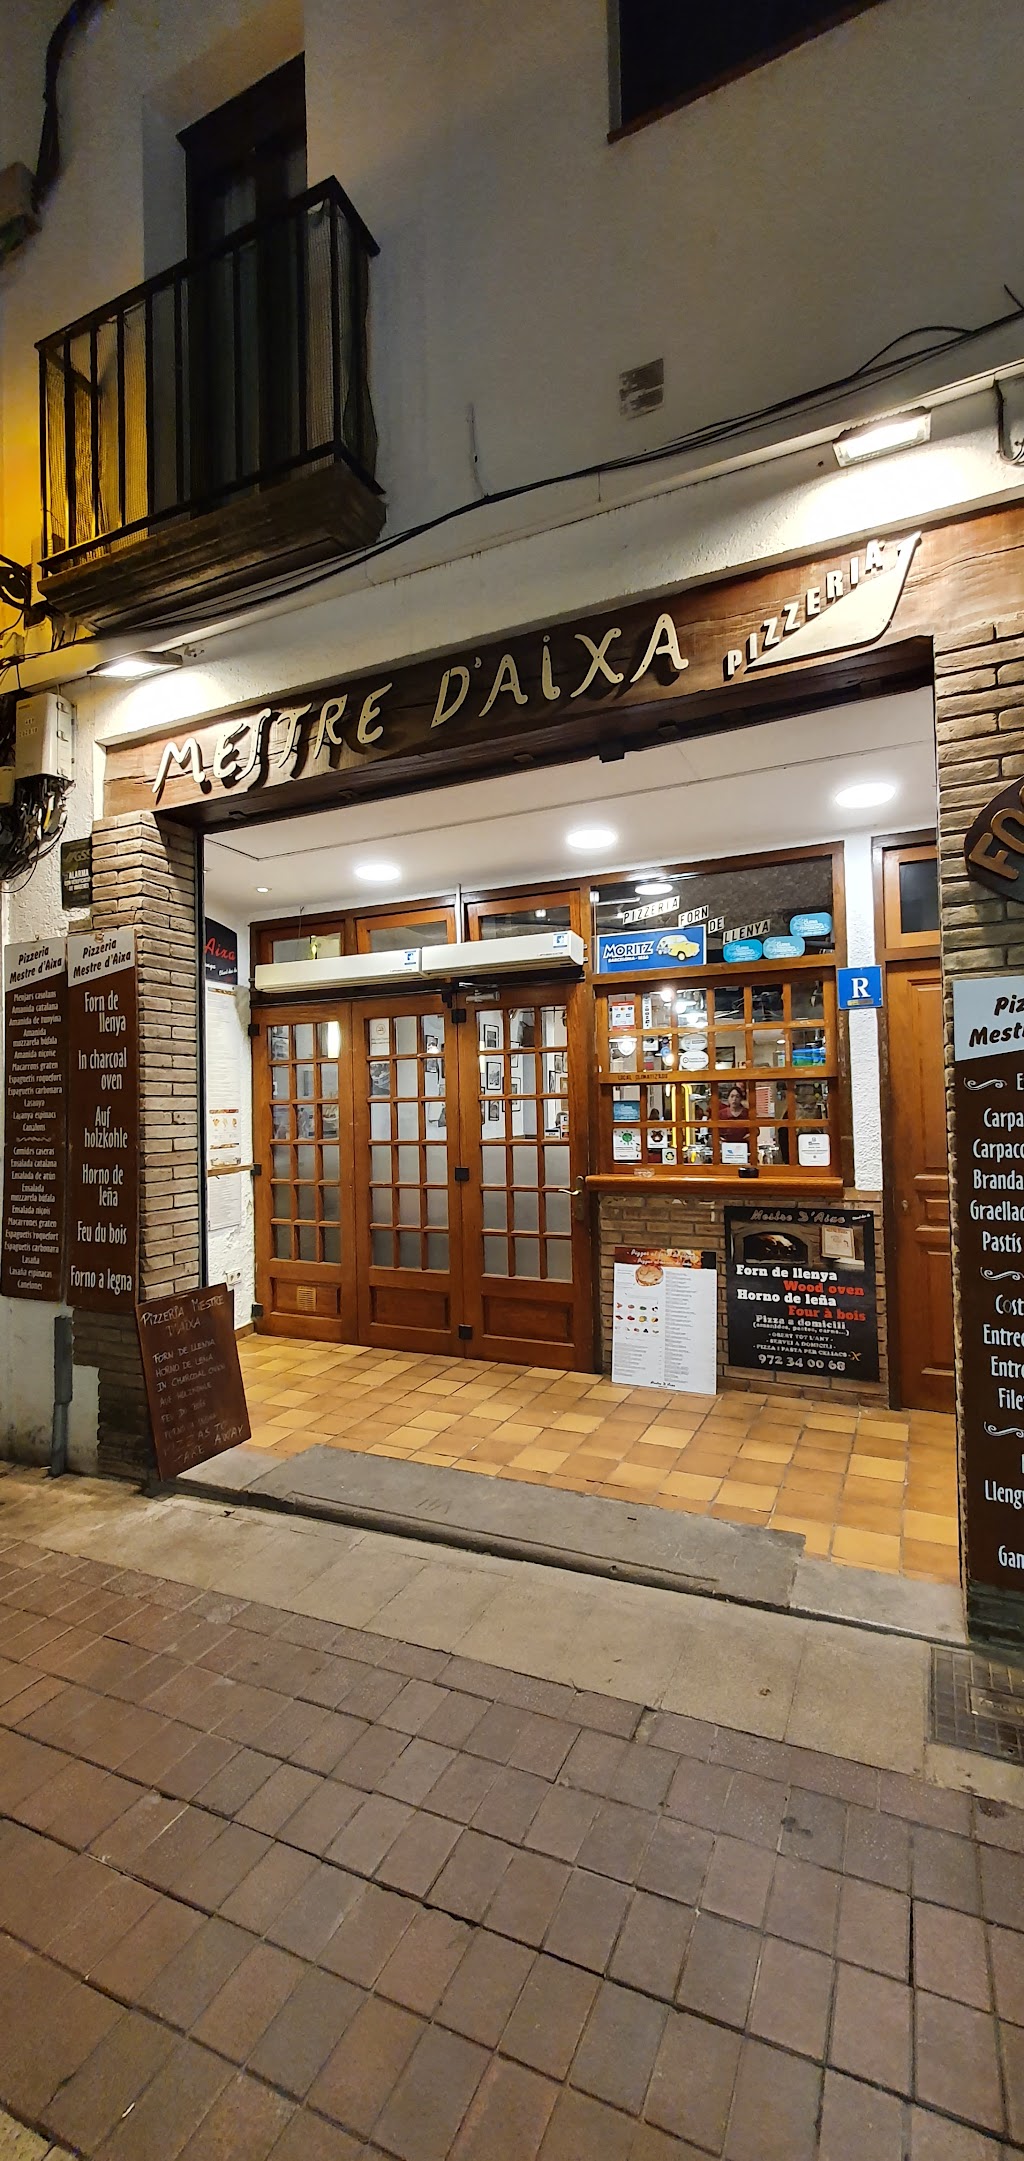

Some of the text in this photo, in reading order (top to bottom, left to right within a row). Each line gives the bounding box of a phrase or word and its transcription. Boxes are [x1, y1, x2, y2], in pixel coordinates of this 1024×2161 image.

[728, 539, 882, 676] PIZZERIA
[152, 683, 392, 793] MESTRE
[969, 785, 1024, 880] FO
[623, 898, 679, 923] PIZZERIA
[680, 906, 708, 925] FORN
[710, 918, 724, 932] DE
[724, 920, 769, 943] LLENYA
[18, 946, 49, 965] Pizzeria
[82, 938, 117, 959] Pizzeria
[603, 942, 653, 958] MORITZ
[9, 957, 62, 984] Mestre d'Aixa
[73, 951, 131, 978] Mestre d'Aixa
[851, 977, 871, 999] R
[84, 990, 119, 1013] Forn de
[33, 1015, 40, 1024] de
[99, 1012, 126, 1037] llenya
[969, 1022, 1024, 1047] Mest
[78, 1047, 127, 1070] In charcoal
[101, 1073, 123, 1090] oven
[95, 1105, 111, 1128] Auf
[983, 1107, 1024, 1132] Carpa
[84, 1127, 128, 1149] holzkohle
[35, 1171, 42, 1180] de
[82, 1163, 123, 1186] Horno de
[973, 1169, 1024, 1191] Branda
[99, 1185, 118, 1207] leña
[77, 1220, 127, 1245] Feu du bois
[70, 1265, 132, 1295] Forno a legna
[736, 1264, 838, 1282] Forn de llenya
[737, 1289, 837, 1306] Horno de leña
[783, 1280, 865, 1296] Wood oven
[756, 1314, 785, 1325] Pizza
[797, 1318, 846, 1330] domicili
[788, 1305, 866, 1321] Four à bois
[153, 1351, 174, 1363] FORN
[178, 1347, 189, 1356] DE
[758, 1354, 845, 1371] 972 34 00 68
[155, 1364, 180, 1377] HORNO
[182, 1360, 192, 1369] DE
[214, 1424, 244, 1445] AWAY
